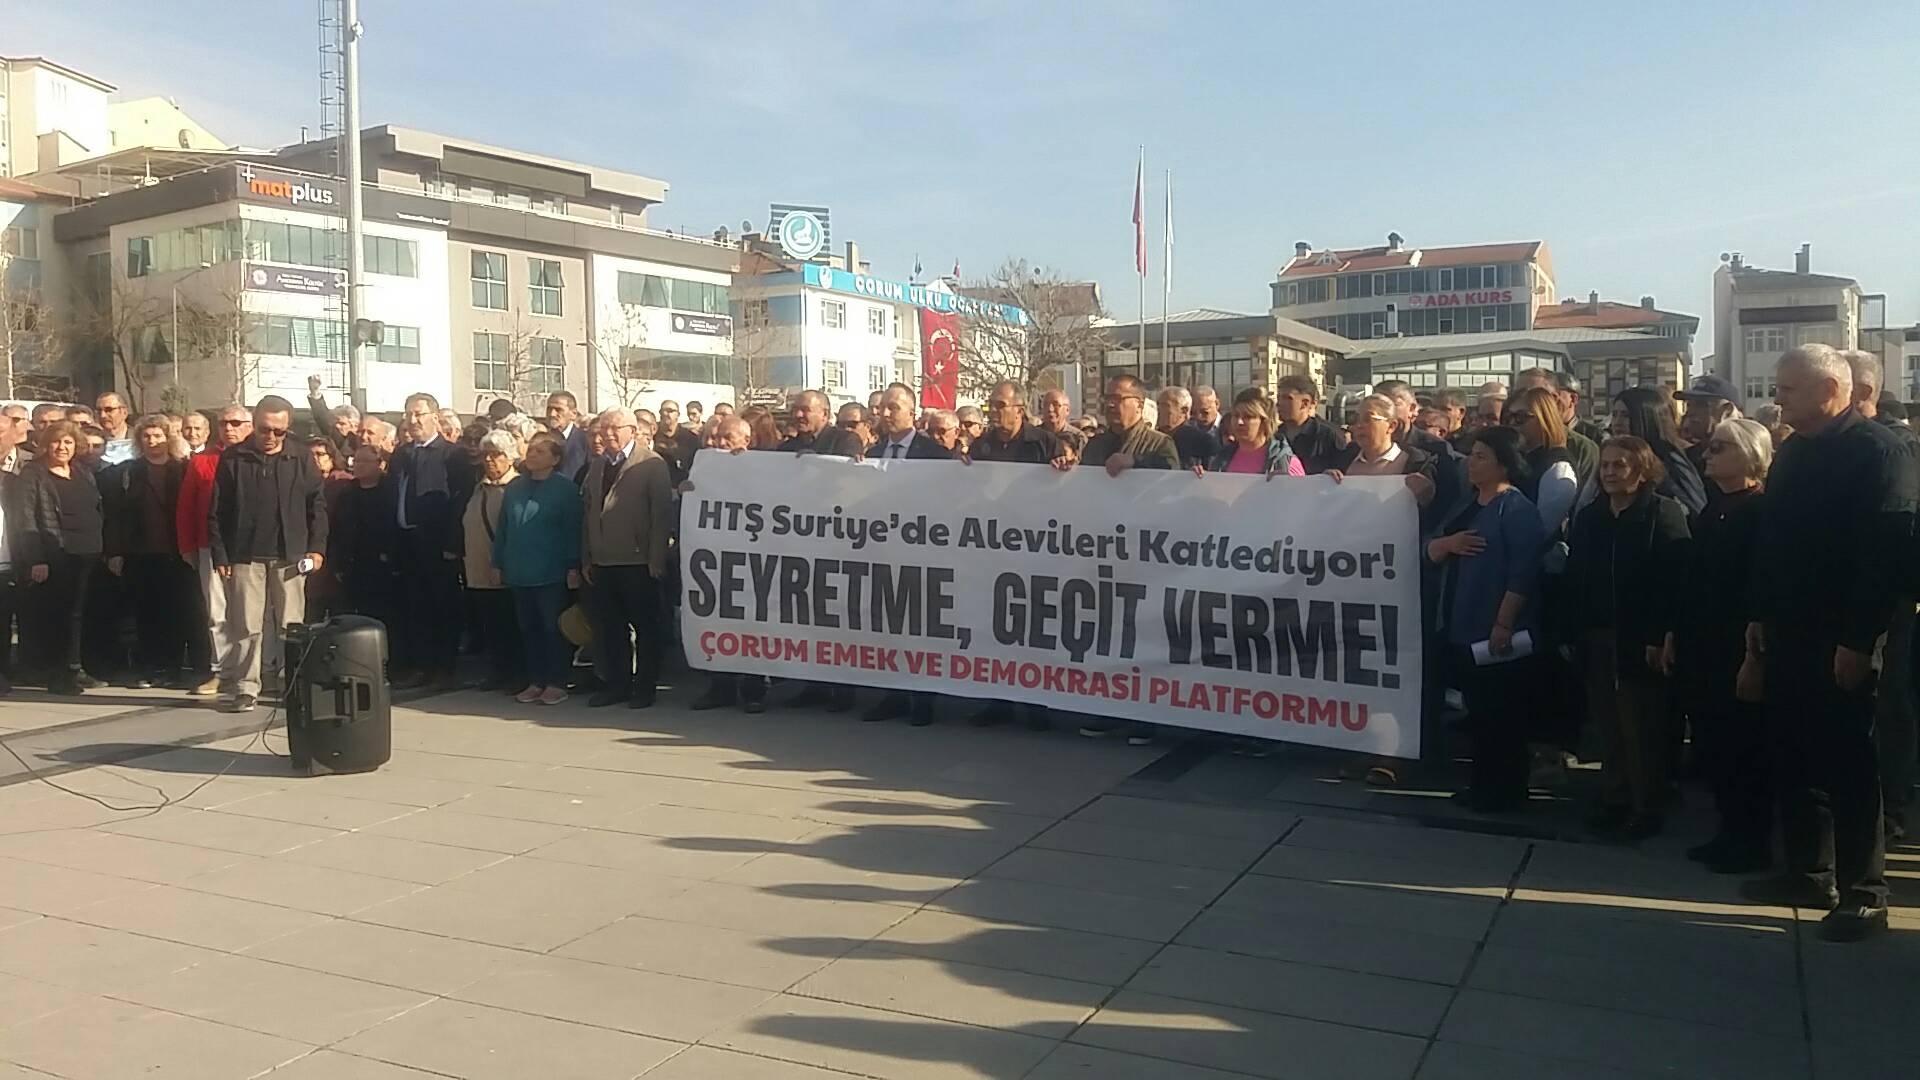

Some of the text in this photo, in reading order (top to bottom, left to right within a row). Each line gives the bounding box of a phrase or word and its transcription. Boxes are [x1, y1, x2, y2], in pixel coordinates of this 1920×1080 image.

[250, 179, 333, 204] matplus
[1425, 290, 1513, 307] ADA KURS
[698, 499, 764, 542] HTŞ
[958, 517, 1129, 561] Alevileri
[1139, 529, 1396, 587] Katlediyor!
[688, 549, 1400, 690] SEYRETME, GEÇİT VERME!
[700, 631, 1369, 732] ÇORUM EMEK VE DEMOKRASİ PLATFORMU
